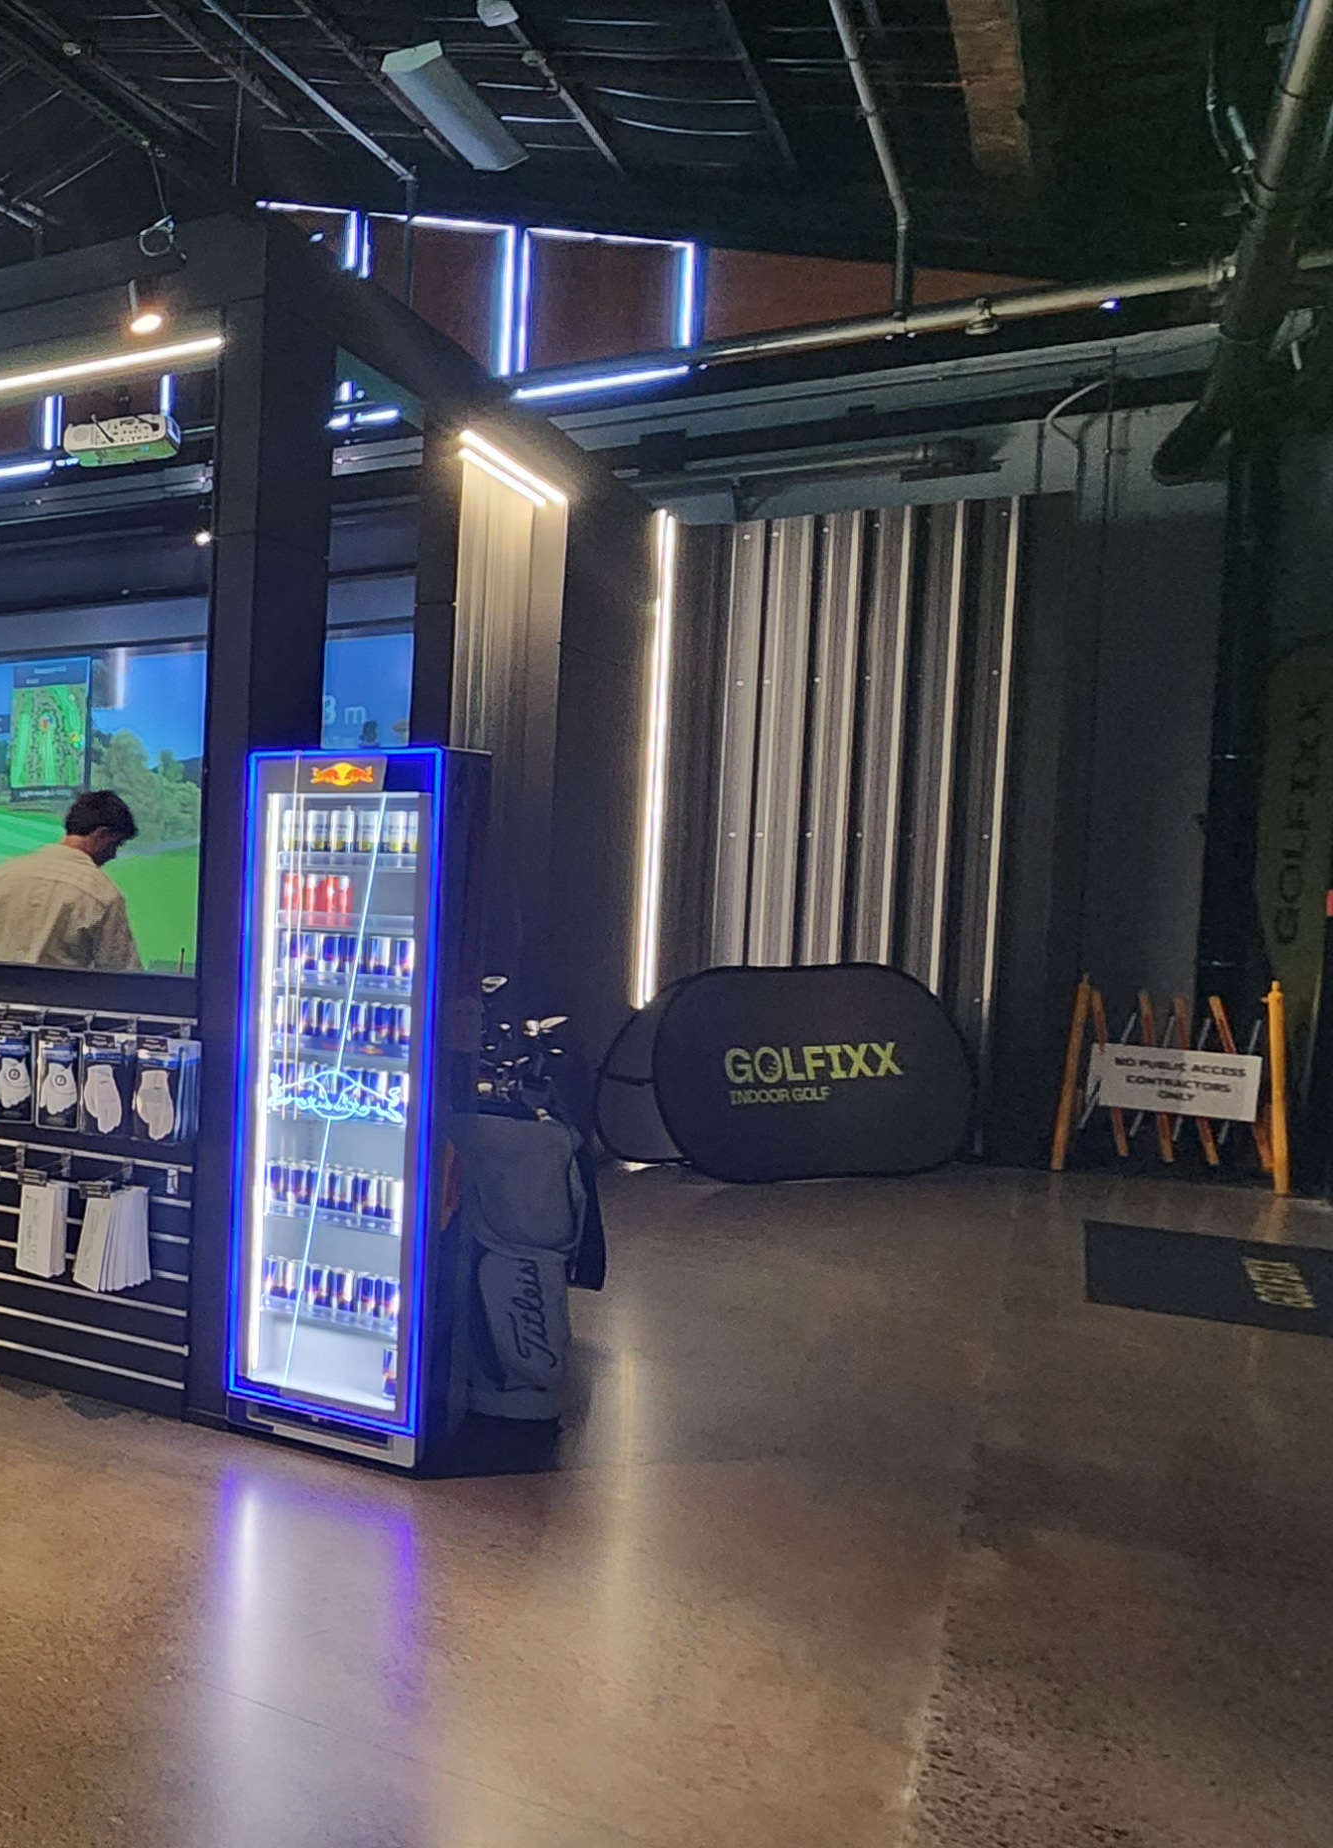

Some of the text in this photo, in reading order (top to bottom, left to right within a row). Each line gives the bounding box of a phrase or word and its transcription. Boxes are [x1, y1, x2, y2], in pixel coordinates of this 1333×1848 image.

[724, 1042, 904, 1084] GOLFIXX
[1114, 1056, 1246, 1078] NO PUBLIC ACCESS
[1125, 1074, 1232, 1093] CONTRACTORS
[729, 1086, 832, 1106] INDOOR GOLF
[1157, 1090, 1196, 1102] ONLY
